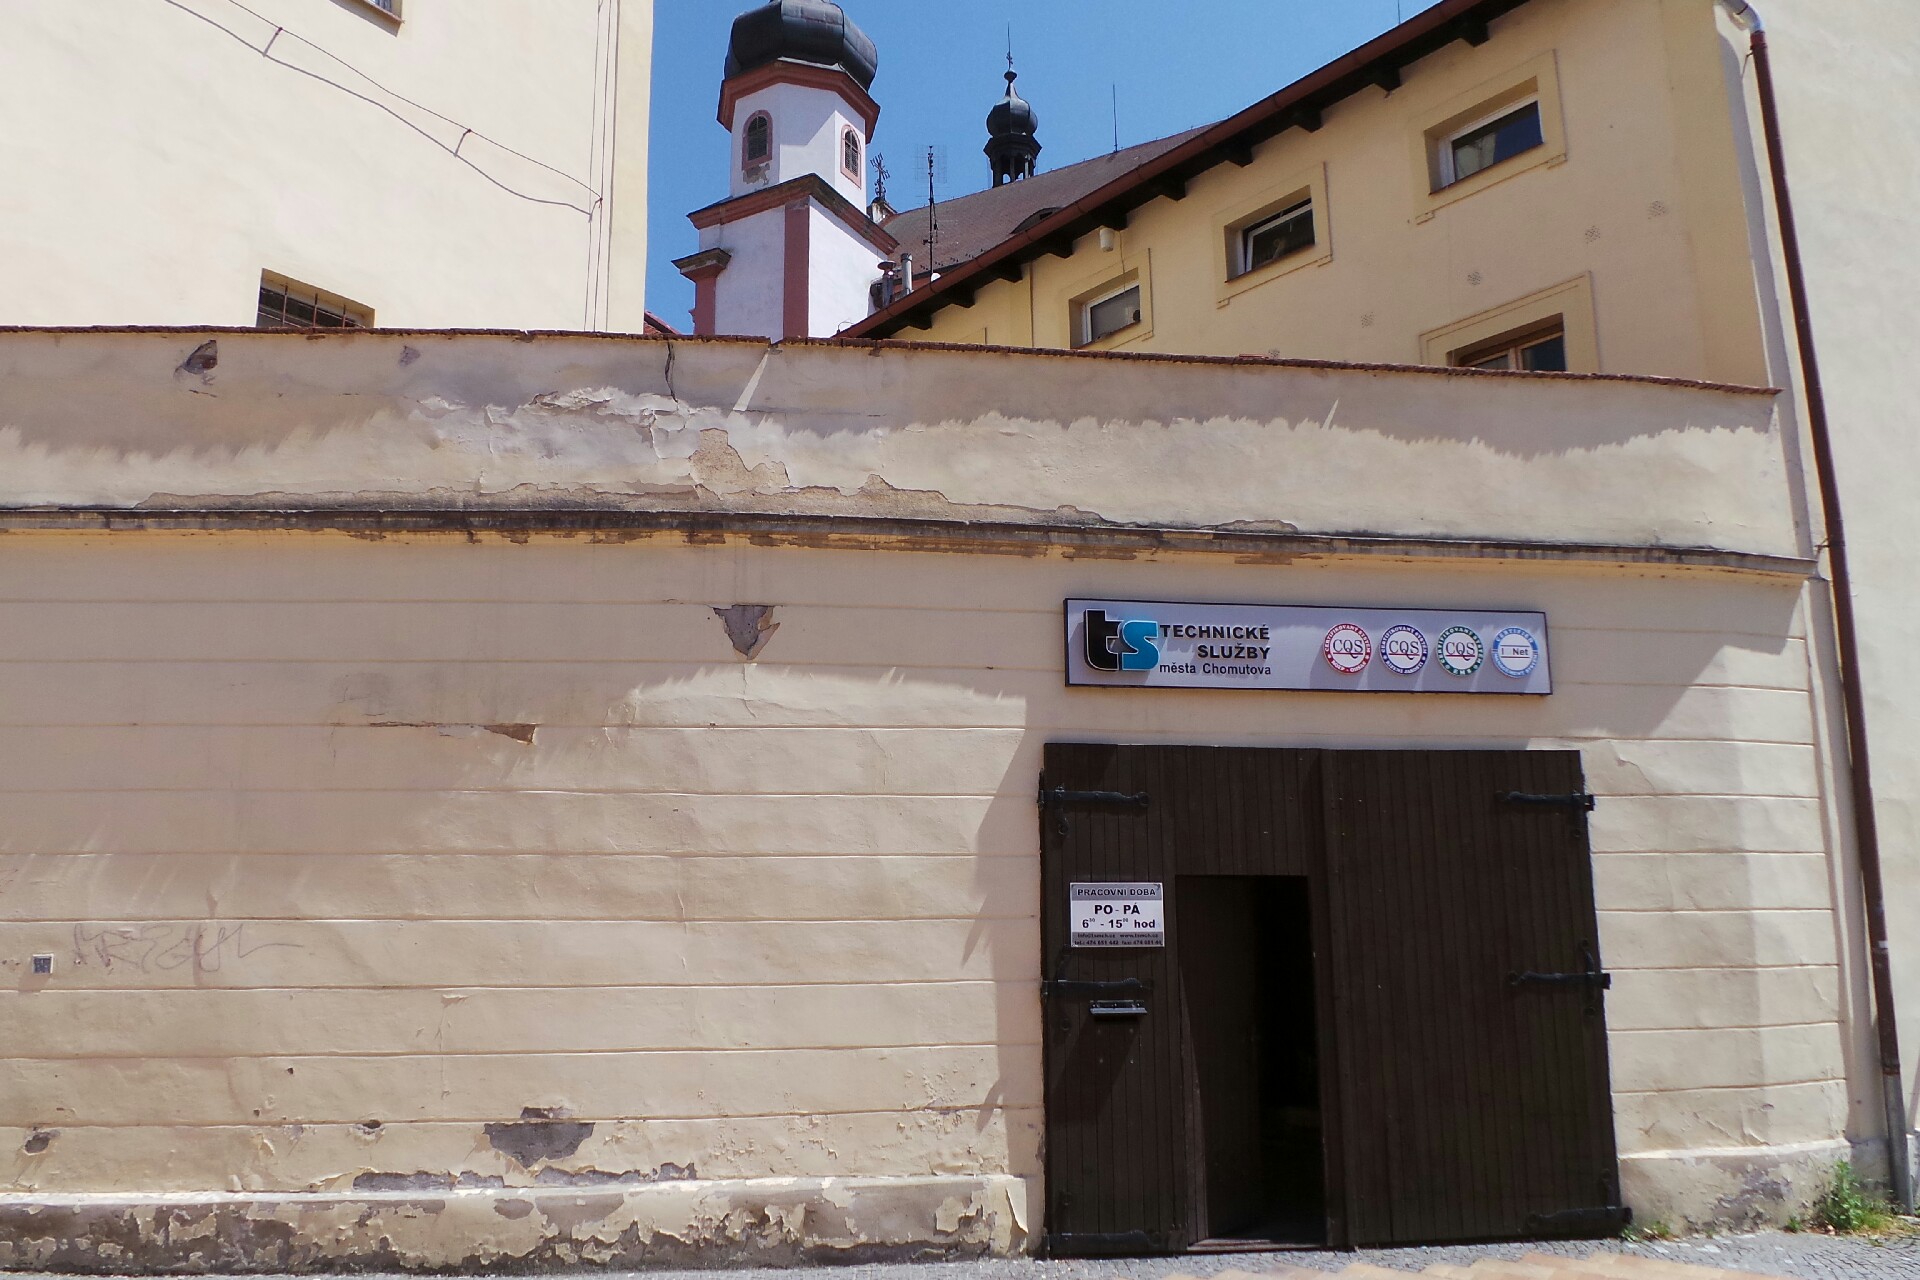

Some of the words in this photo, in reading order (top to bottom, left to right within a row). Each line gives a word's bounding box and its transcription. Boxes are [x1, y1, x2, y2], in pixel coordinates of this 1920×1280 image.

[1160, 623, 1270, 640] TECHNICKÉ
[1197, 643, 1271, 660] SLUŽBY
[1333, 639, 1364, 659] CQS
[1388, 640, 1420, 660] CQS
[1445, 641, 1475, 661] CQS
[1159, 661, 1196, 674] města
[1202, 662, 1272, 675] Chomutova
[1130, 888, 1156, 896] DOBA
[1094, 904, 1113, 915] PO
[1123, 902, 1140, 915] PÁ
[1134, 919, 1156, 929] hod
